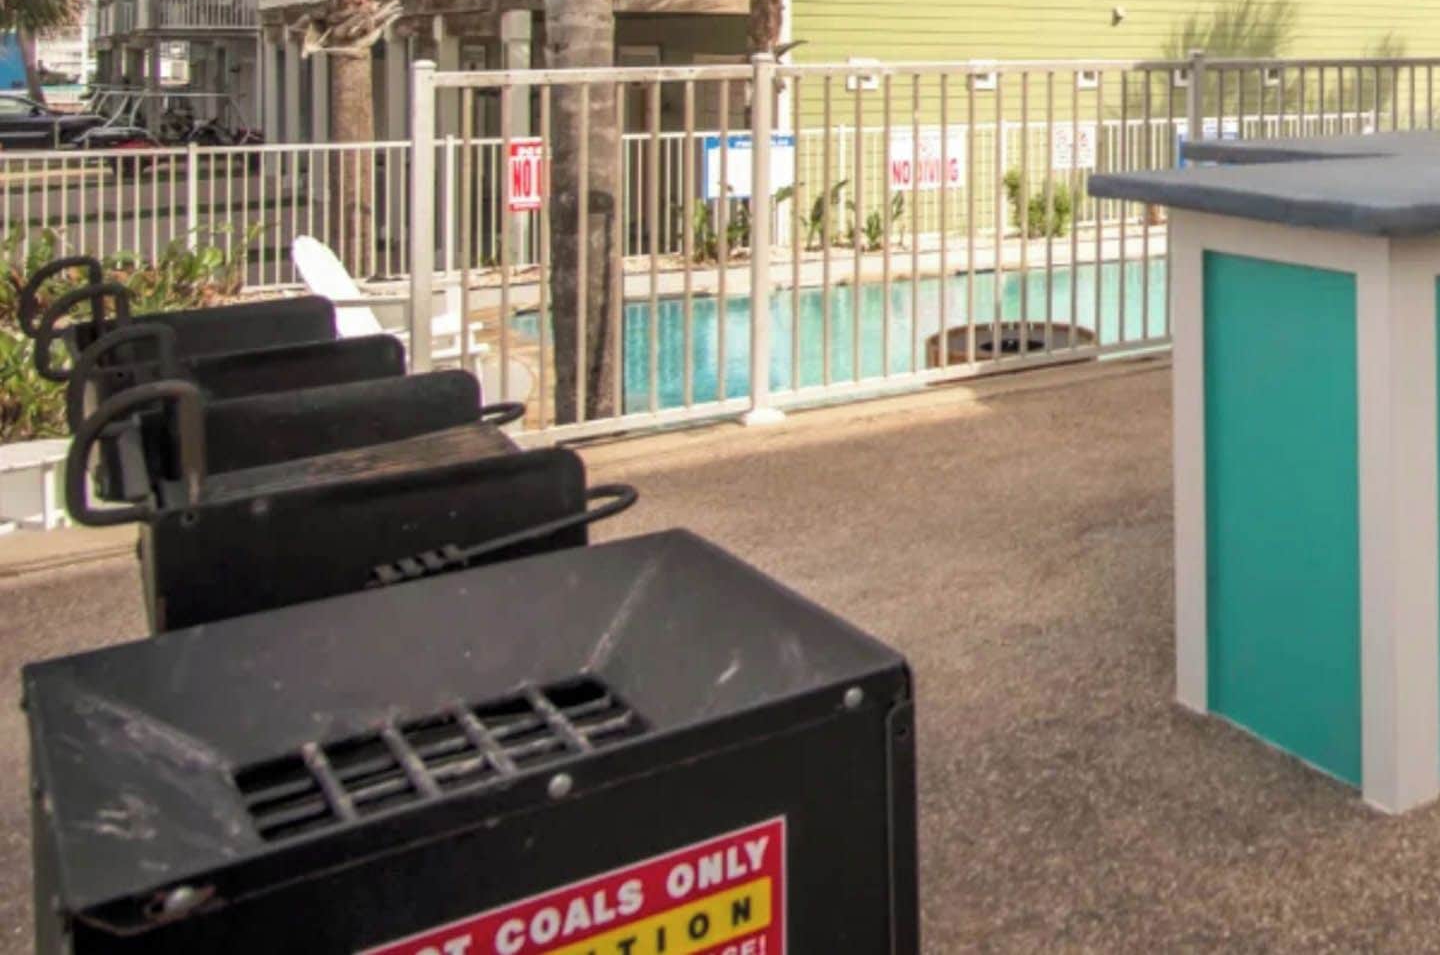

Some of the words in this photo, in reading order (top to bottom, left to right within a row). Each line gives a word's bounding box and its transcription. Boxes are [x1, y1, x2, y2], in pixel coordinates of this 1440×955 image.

[512, 160, 532, 197] NO
[891, 159, 910, 183] NO
[495, 878, 645, 955] COALS
[665, 835, 770, 899] ONLY
